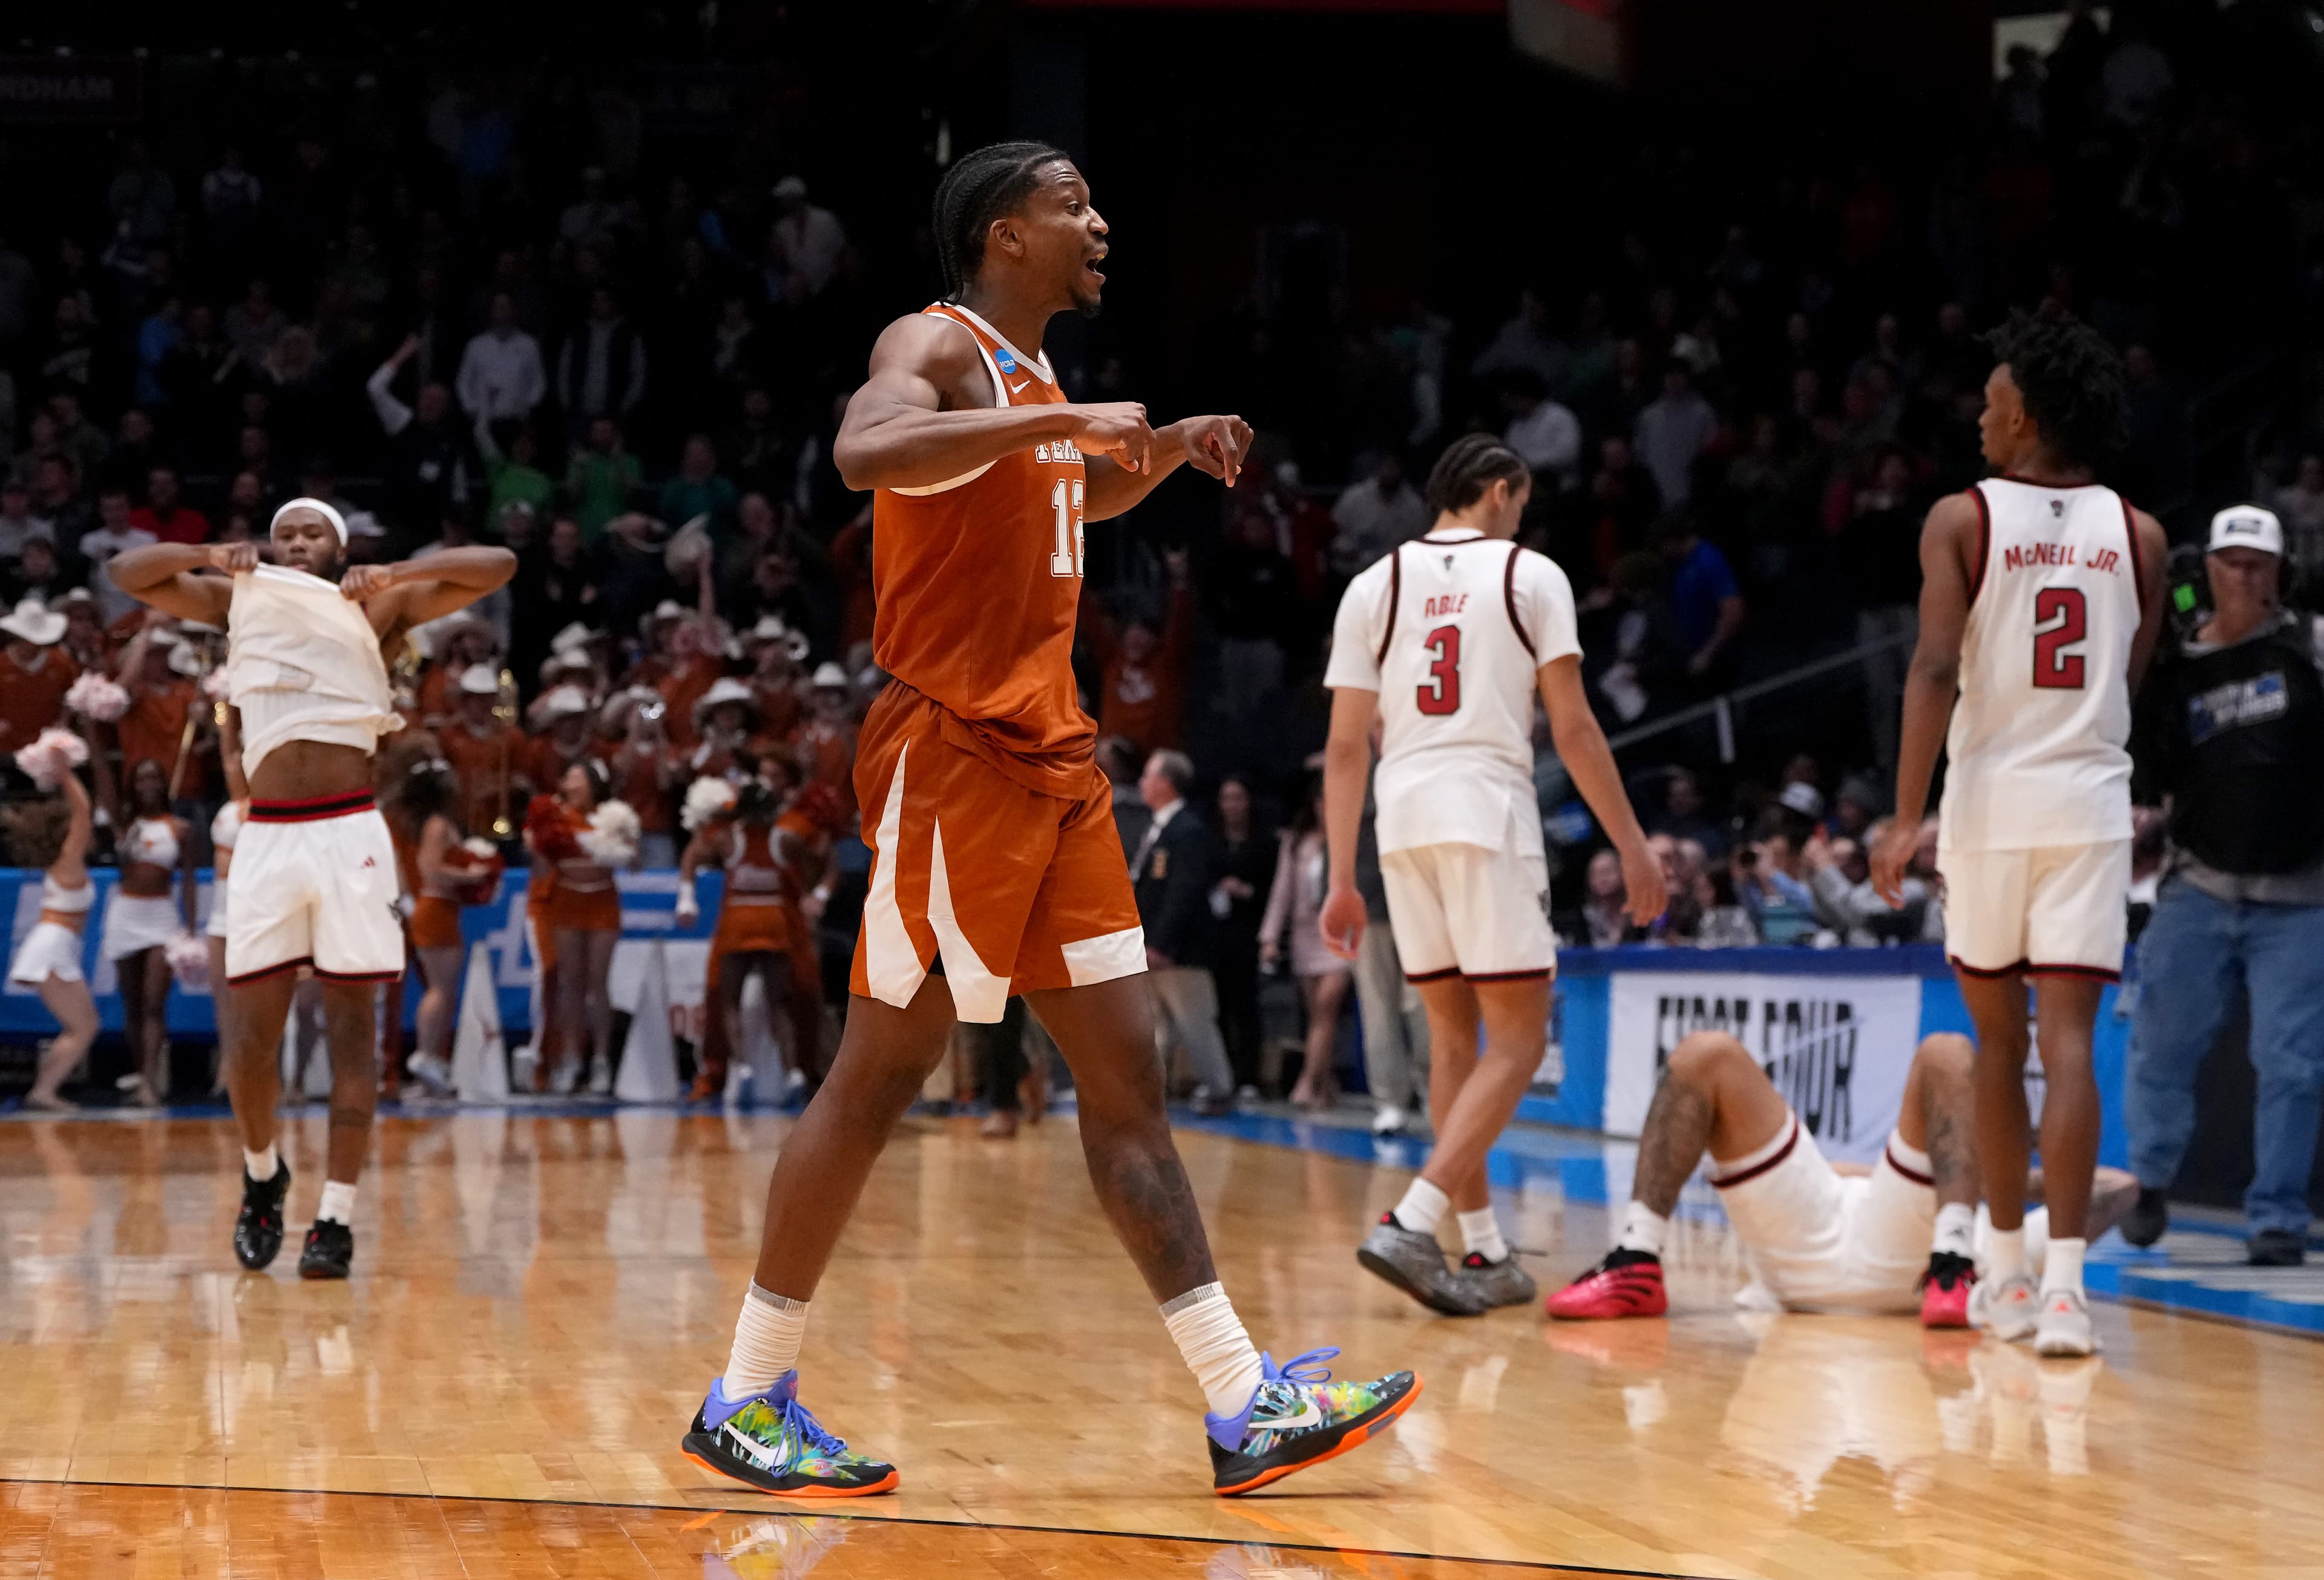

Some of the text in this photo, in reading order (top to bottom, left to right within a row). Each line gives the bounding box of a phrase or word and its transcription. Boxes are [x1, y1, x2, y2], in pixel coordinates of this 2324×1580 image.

[999, 359, 1015, 368] NCAA
[1425, 594, 1469, 618] ABLE
[2033, 587, 2086, 689] 2
[1417, 624, 1461, 715] 3
